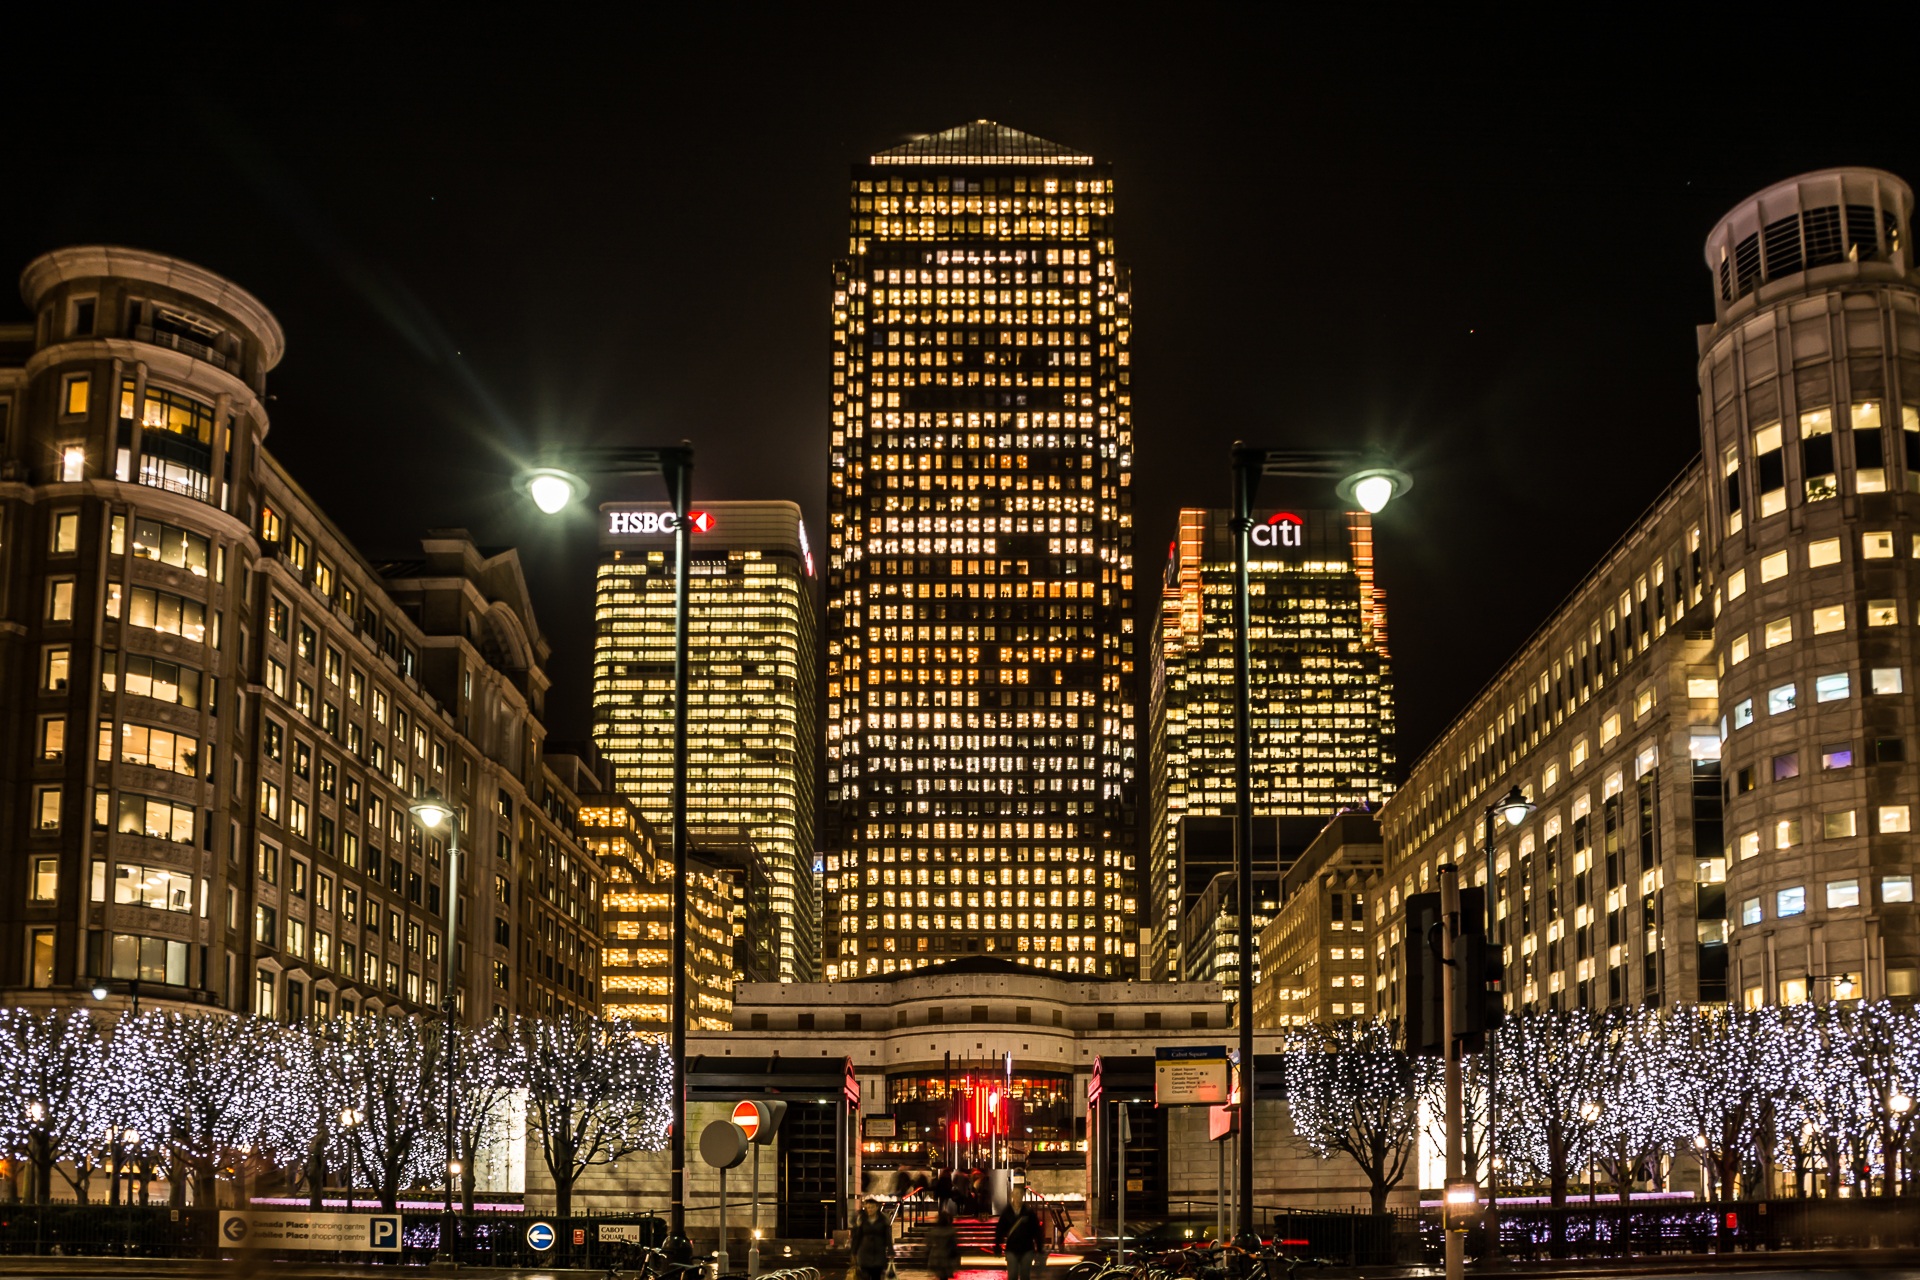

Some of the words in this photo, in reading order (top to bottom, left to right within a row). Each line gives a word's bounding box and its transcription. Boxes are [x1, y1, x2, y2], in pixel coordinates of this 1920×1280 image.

[609, 512, 677, 534] HSBC
[1251, 520, 1302, 547] citi
[252, 1231, 283, 1239] Jubilee
[311, 1233, 342, 1241] shopping
[374, 1221, 393, 1245] P
